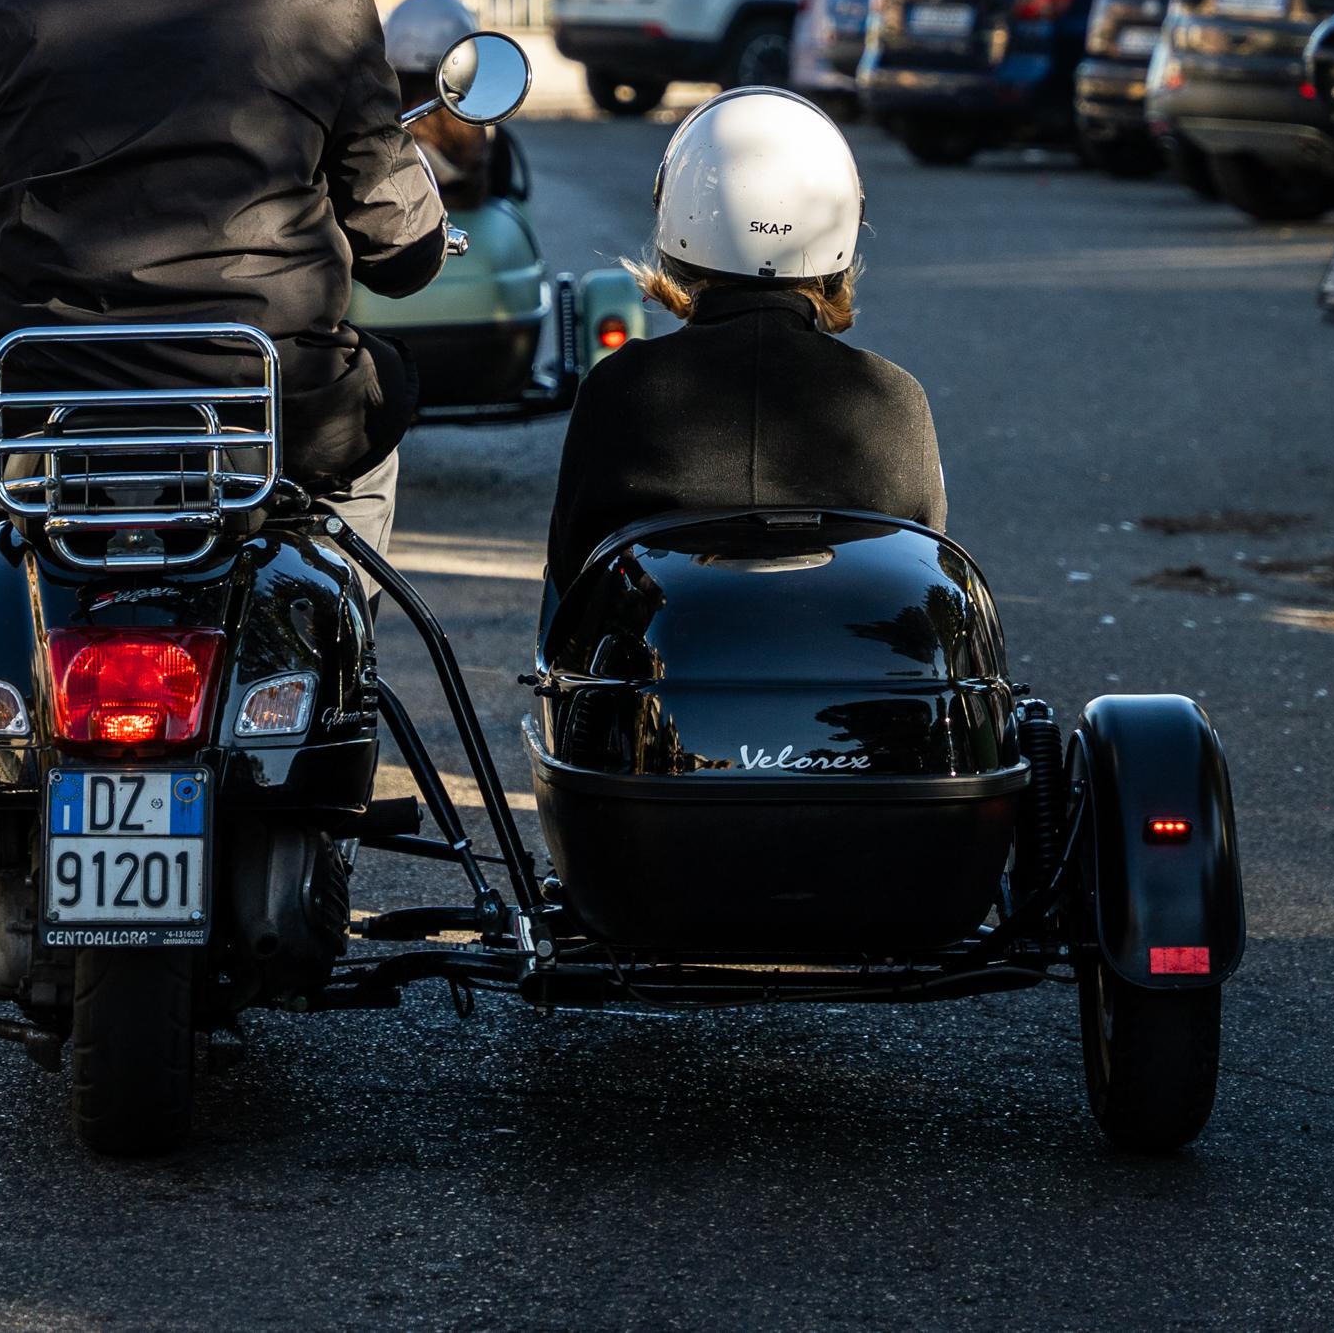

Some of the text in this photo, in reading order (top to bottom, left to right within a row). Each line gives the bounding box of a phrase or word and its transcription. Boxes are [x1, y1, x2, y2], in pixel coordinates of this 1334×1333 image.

[749, 221, 792, 235] SKA-P
[740, 744, 871, 770] Velorex
[90, 776, 146, 831] DZ
[57, 851, 189, 907] 91201
